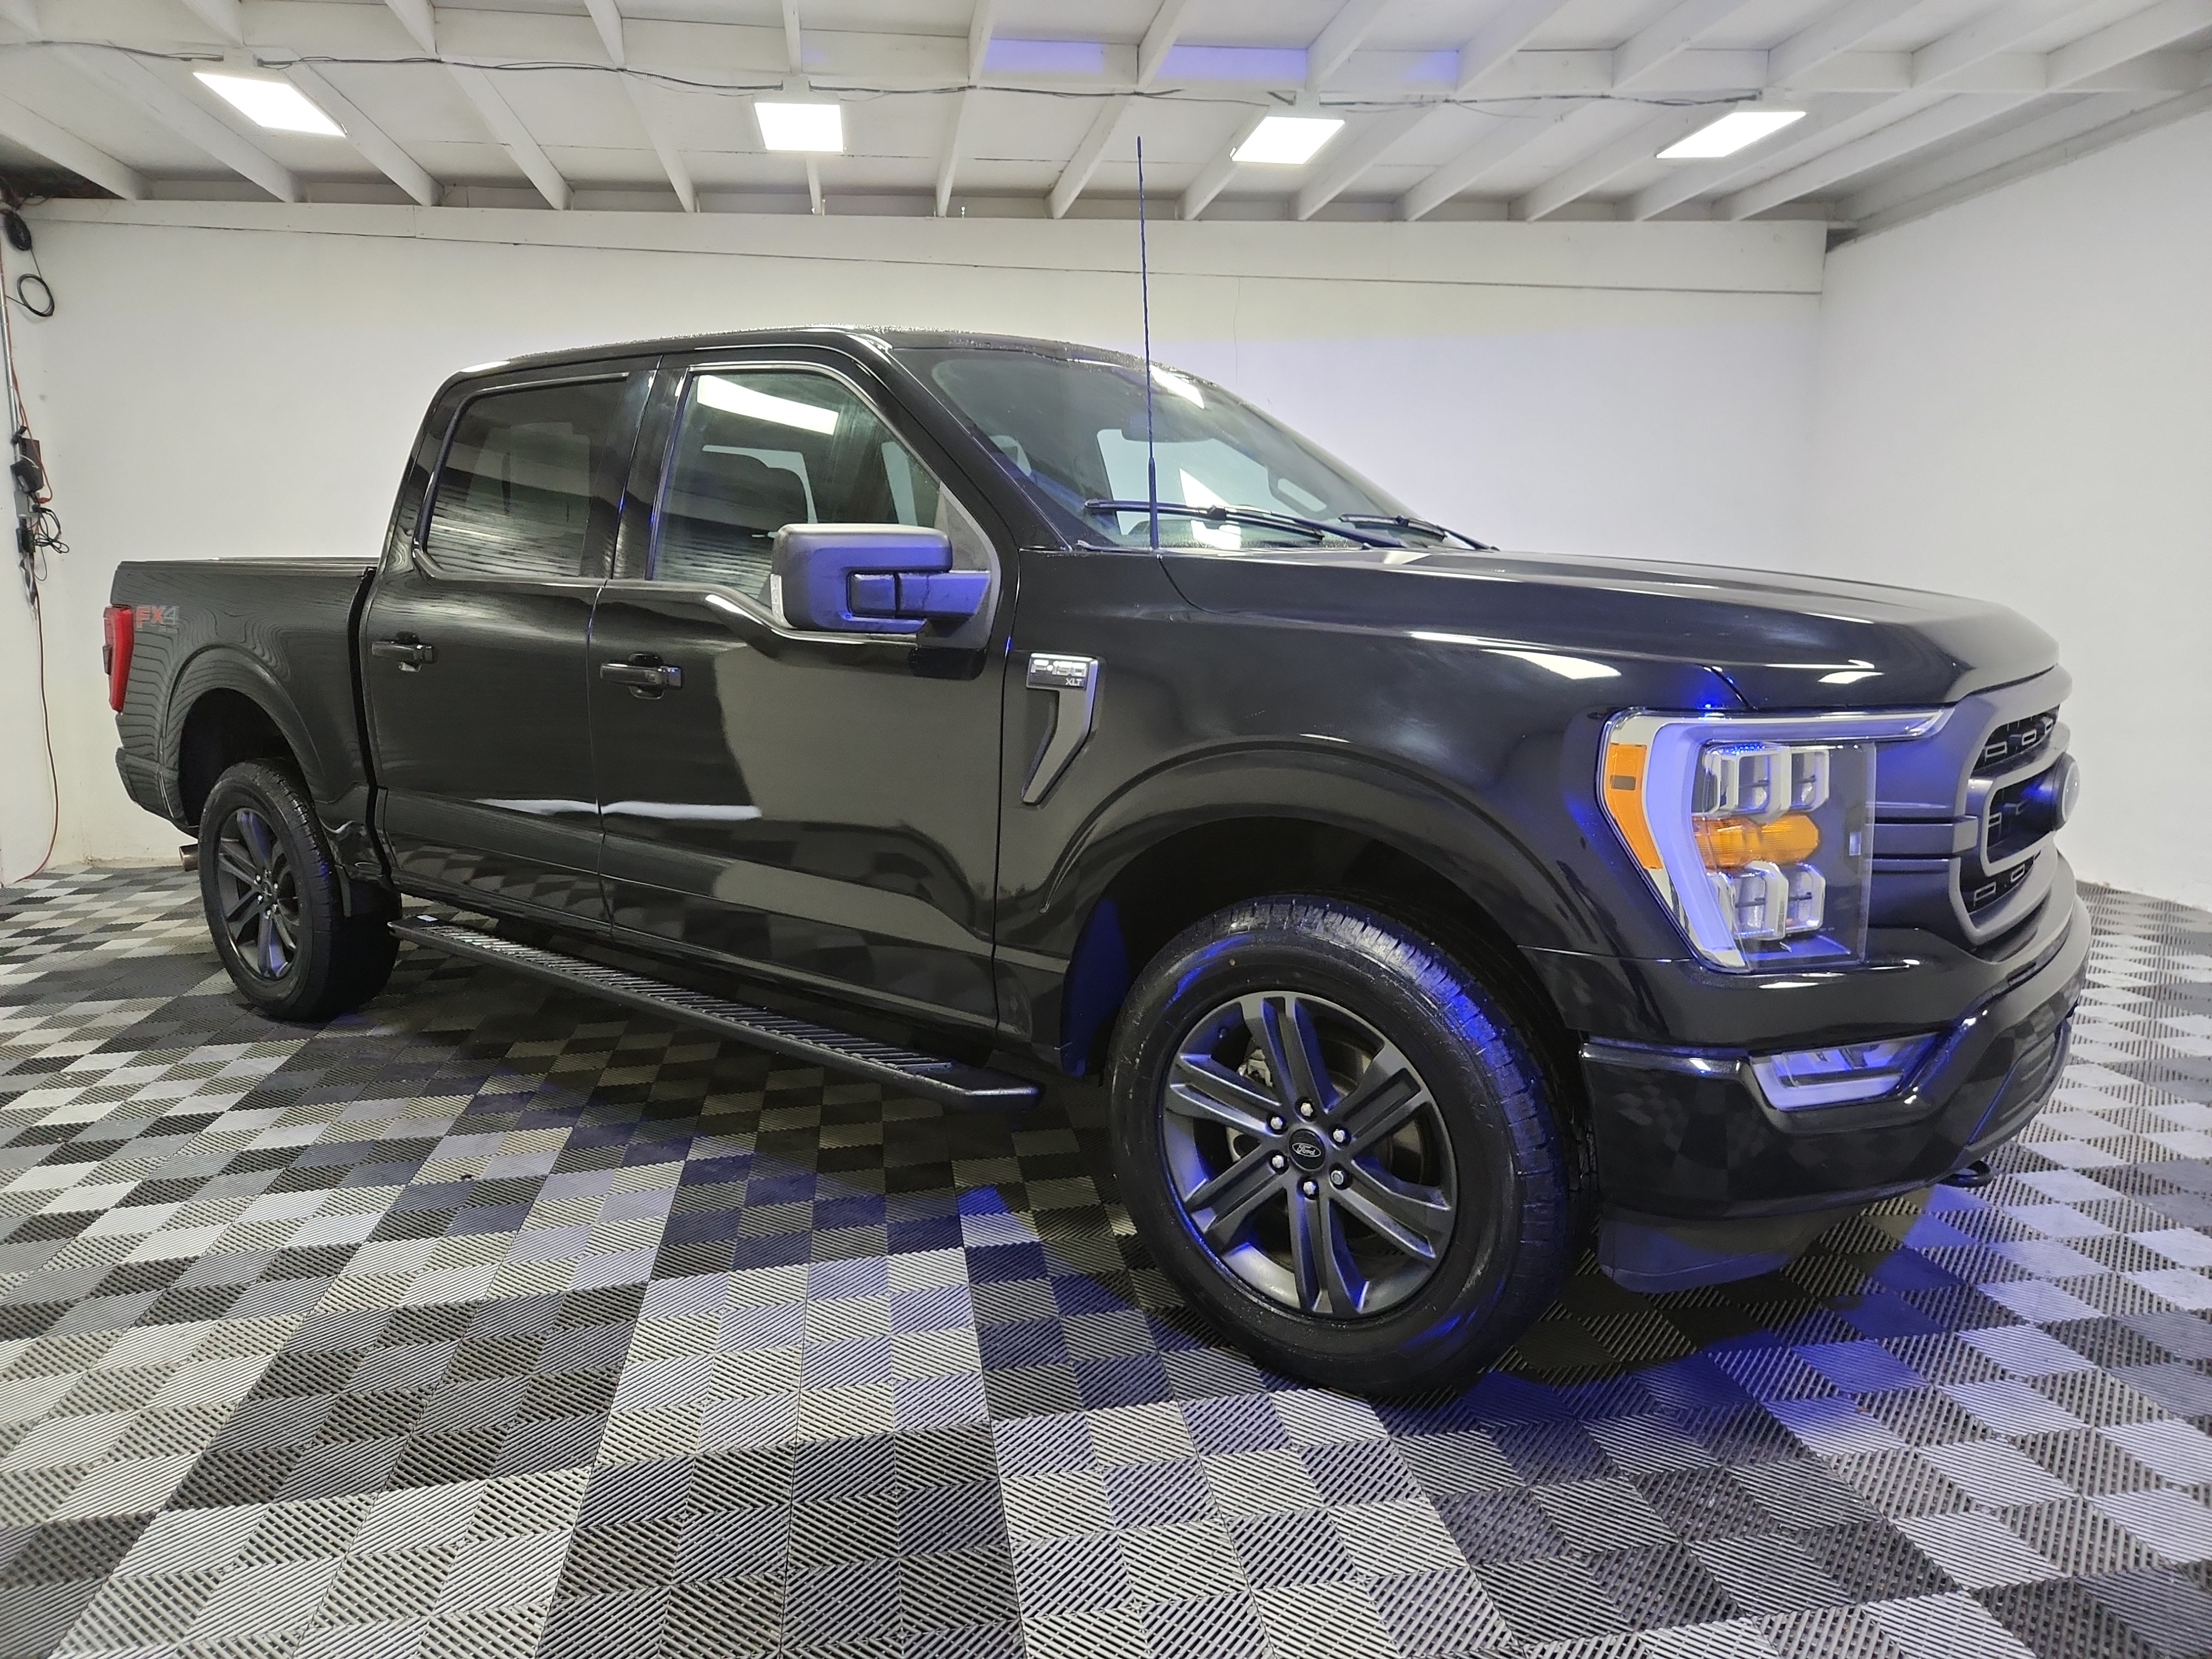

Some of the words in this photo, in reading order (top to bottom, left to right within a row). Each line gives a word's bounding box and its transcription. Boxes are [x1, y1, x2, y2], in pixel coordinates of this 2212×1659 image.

[137, 605, 179, 629] FX4
[1065, 678, 1082, 686] XLT
[1296, 1144, 1316, 1155] Ford
